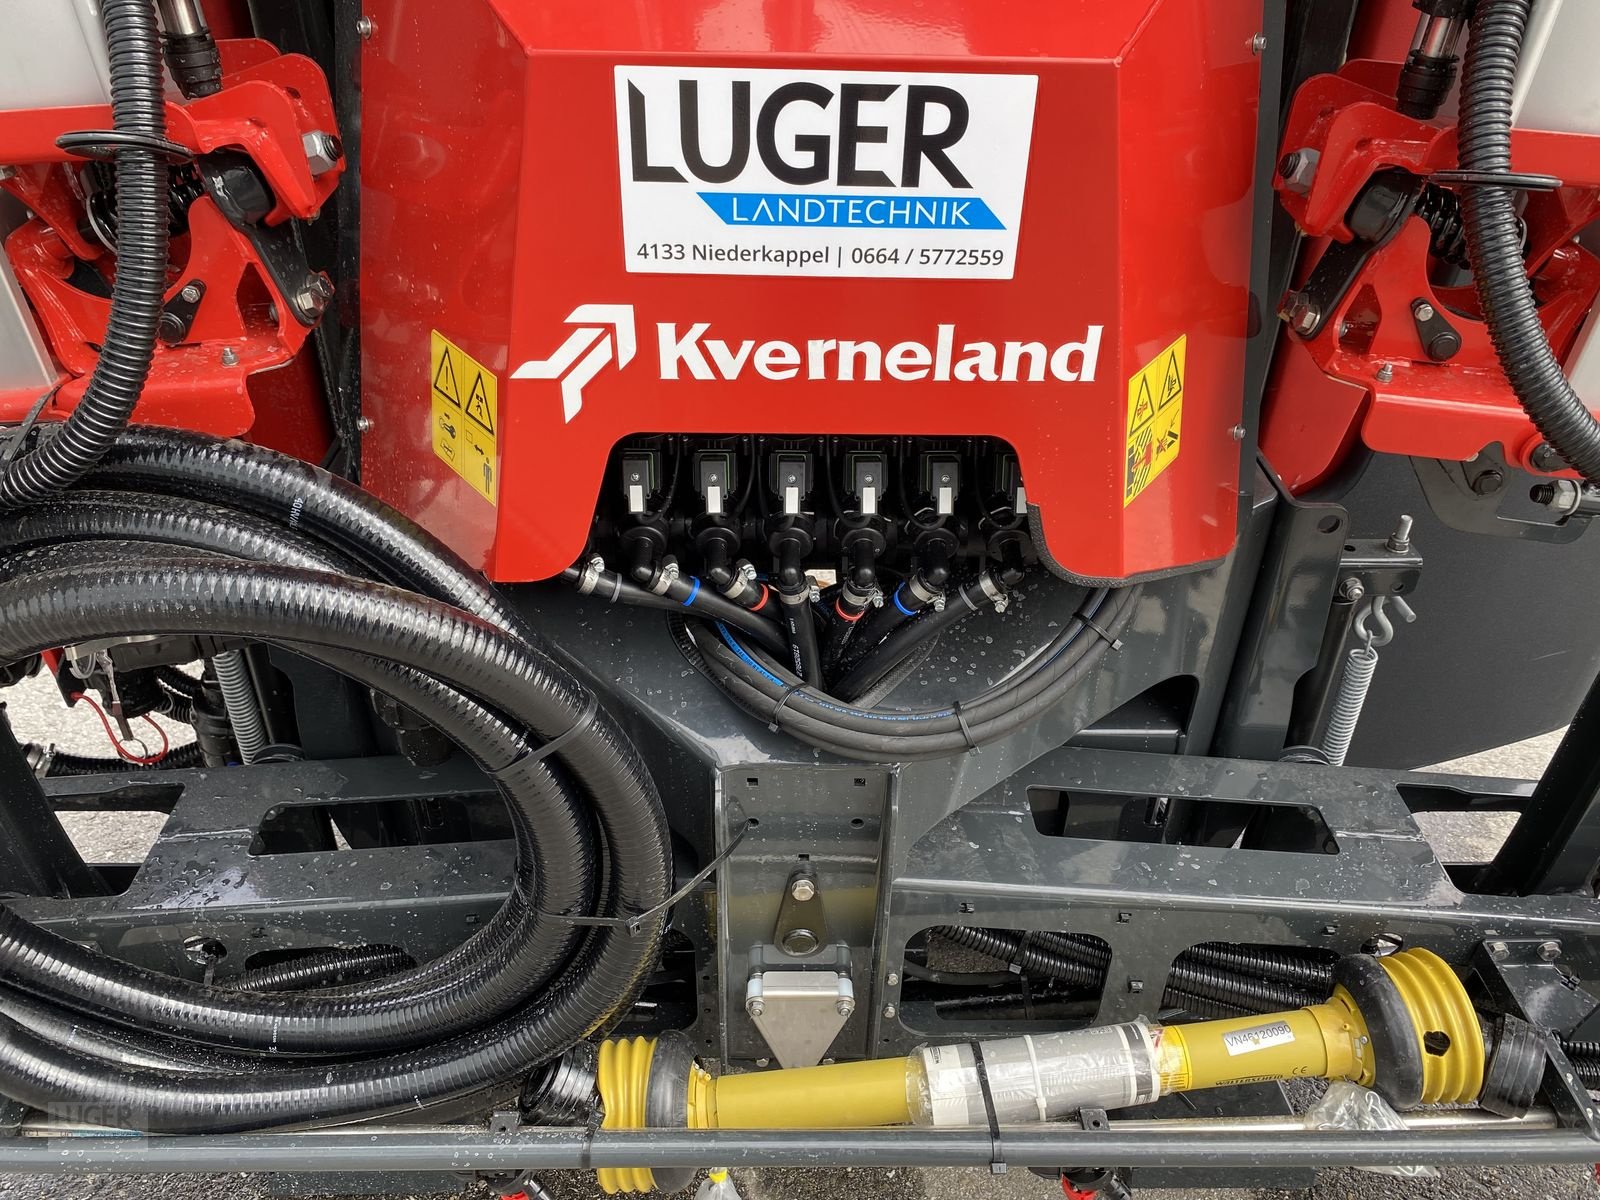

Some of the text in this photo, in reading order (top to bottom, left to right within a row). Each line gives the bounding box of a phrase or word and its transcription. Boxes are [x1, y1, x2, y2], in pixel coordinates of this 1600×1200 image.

[627, 79, 973, 189] LUGER
[732, 197, 971, 226] LANDTECHNIK
[637, 243, 685, 260] 4133
[692, 244, 829, 267] Niederkappel
[851, 247, 900, 264] 0664
[919, 249, 1004, 266] 5772559
[656, 322, 1104, 382] Kverneland
[1225, 1024, 1292, 1047] VN46120090
